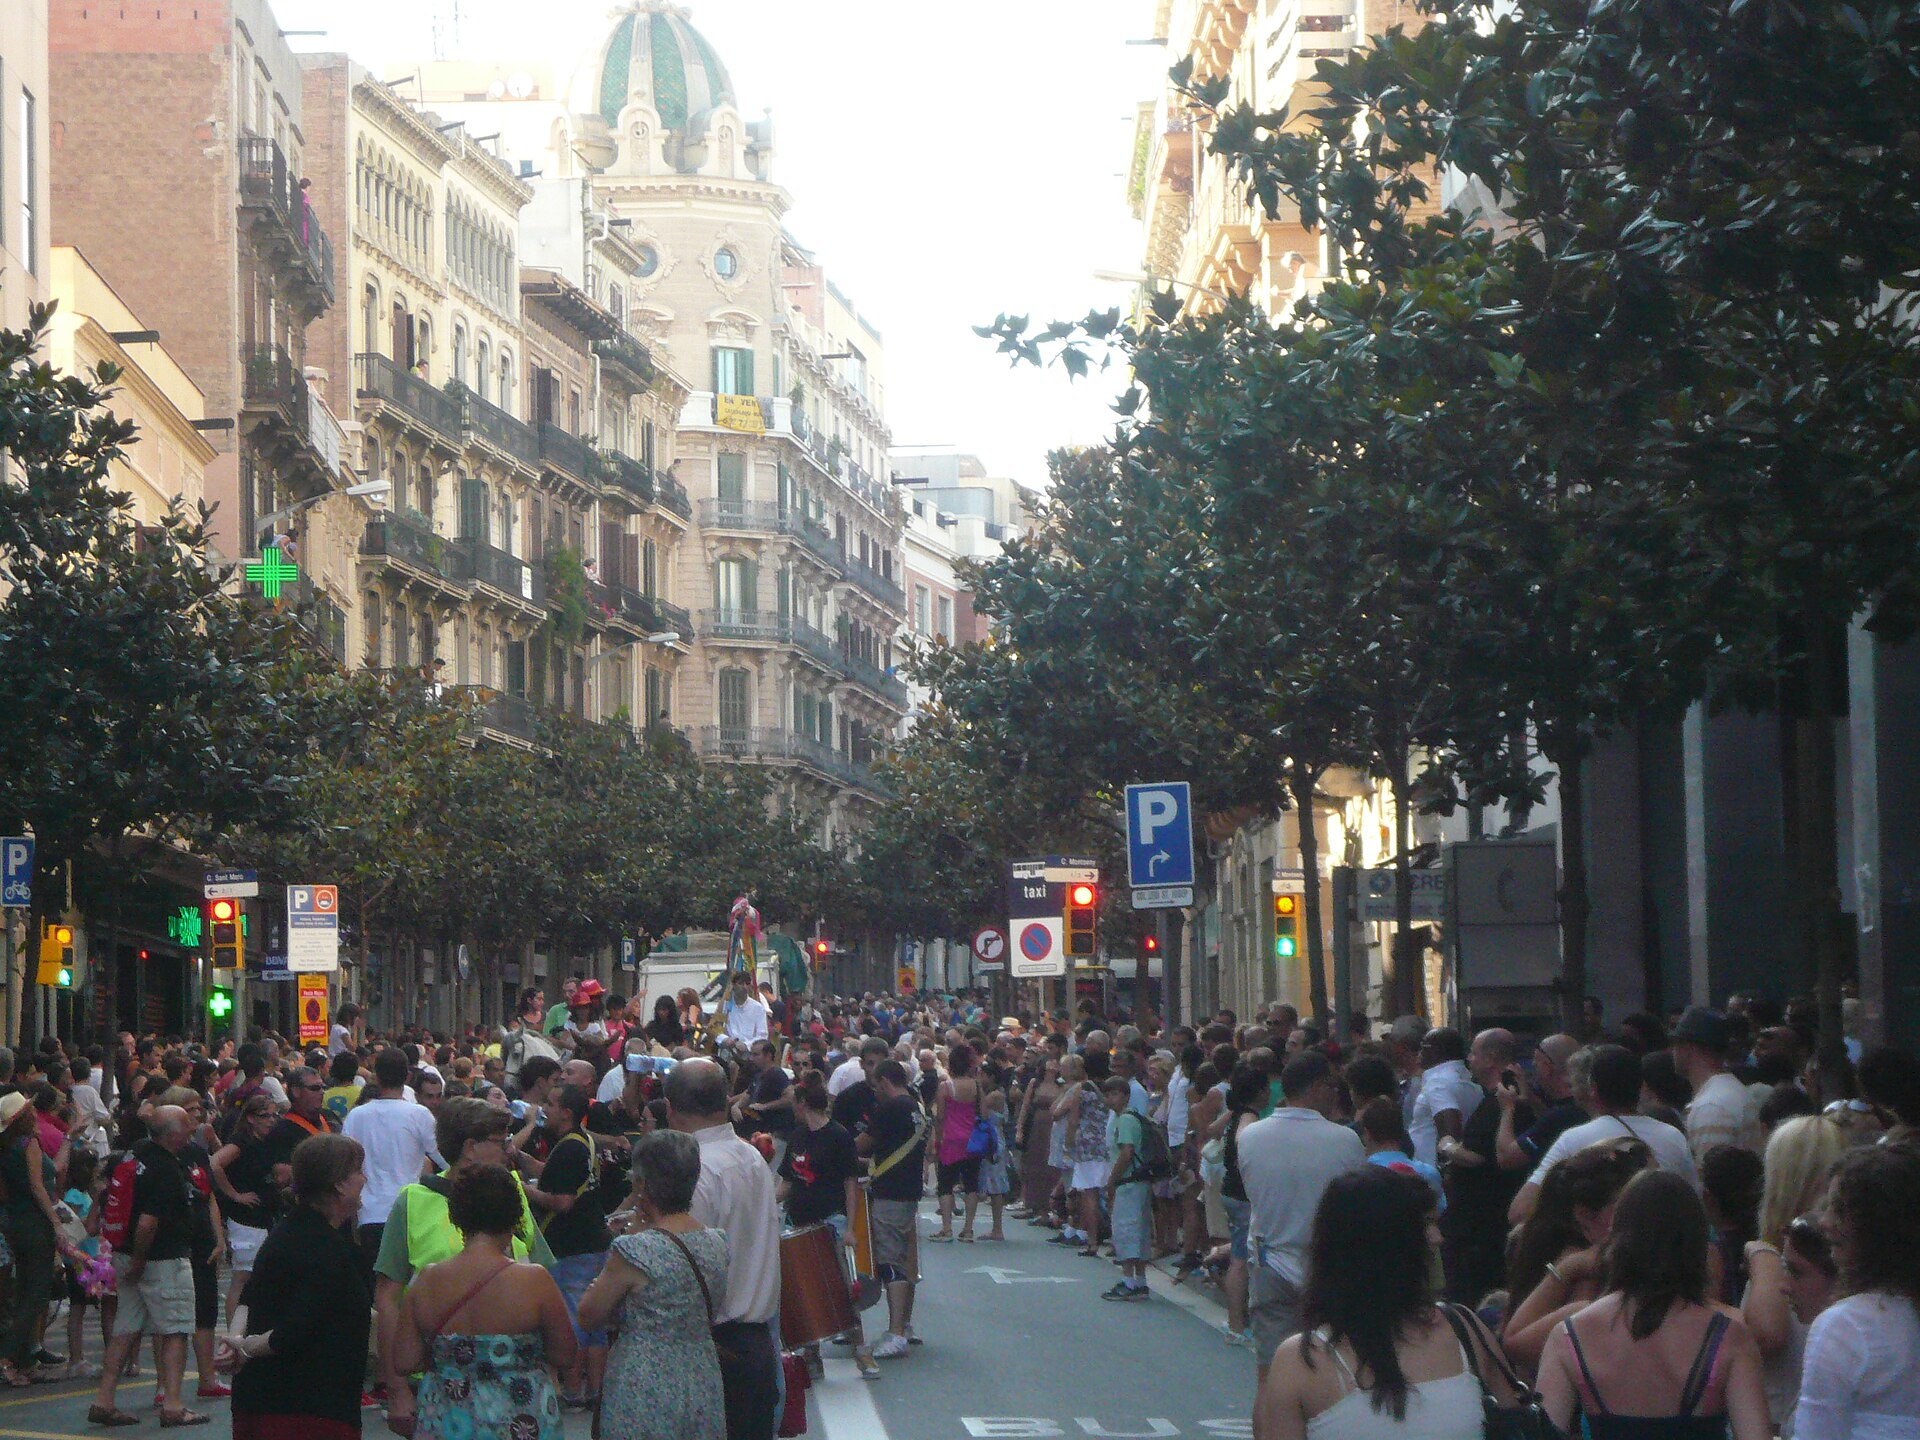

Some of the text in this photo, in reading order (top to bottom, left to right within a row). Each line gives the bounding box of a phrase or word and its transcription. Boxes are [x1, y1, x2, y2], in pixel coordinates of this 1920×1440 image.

[1138, 790, 1178, 845] P
[8, 843, 27, 876] P
[215, 873, 228, 882] Sant
[294, 890, 309, 909] P
[1023, 884, 1046, 898] taxi
[623, 941, 632, 963] P
